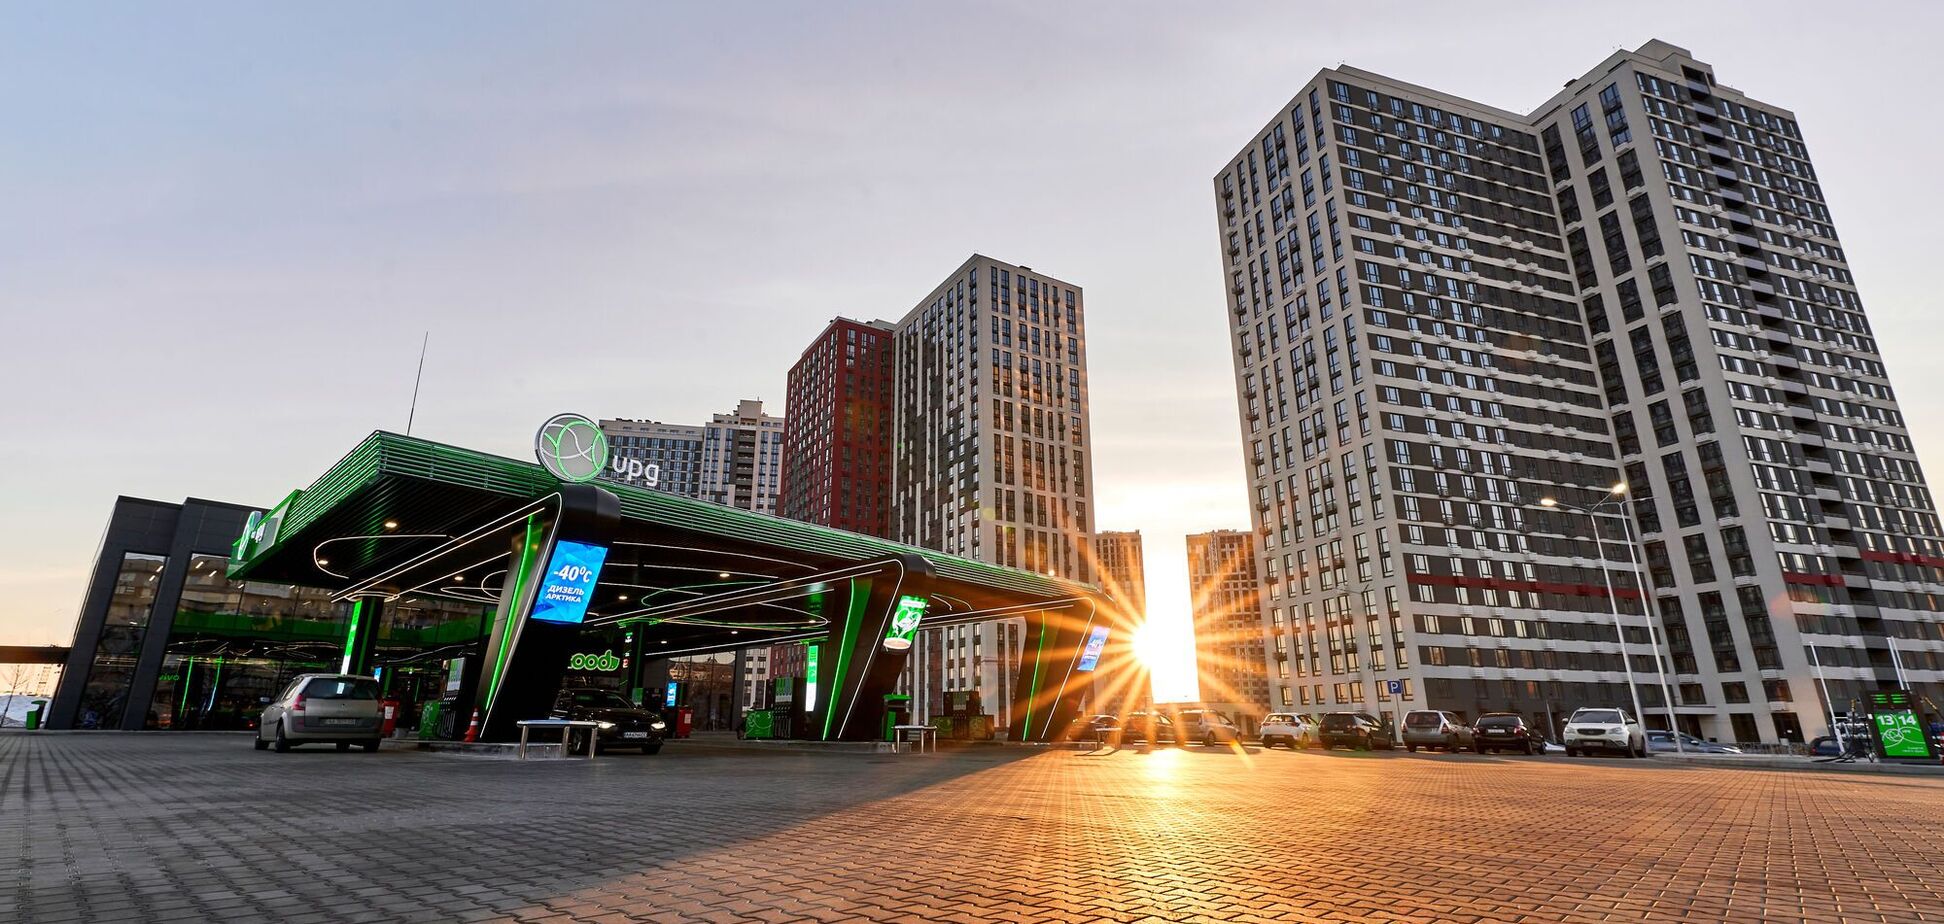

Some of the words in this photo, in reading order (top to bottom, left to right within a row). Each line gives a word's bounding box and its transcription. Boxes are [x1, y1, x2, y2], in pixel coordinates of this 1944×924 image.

[612, 455, 659, 487] upg
[548, 585, 585, 596] ДИЗЕЛЬ
[545, 594, 582, 603] АРКТИКА
[567, 649, 620, 671] ood
[1390, 682, 1399, 693] P
[1877, 715, 1895, 726] 13
[1898, 715, 1917, 726] 14
